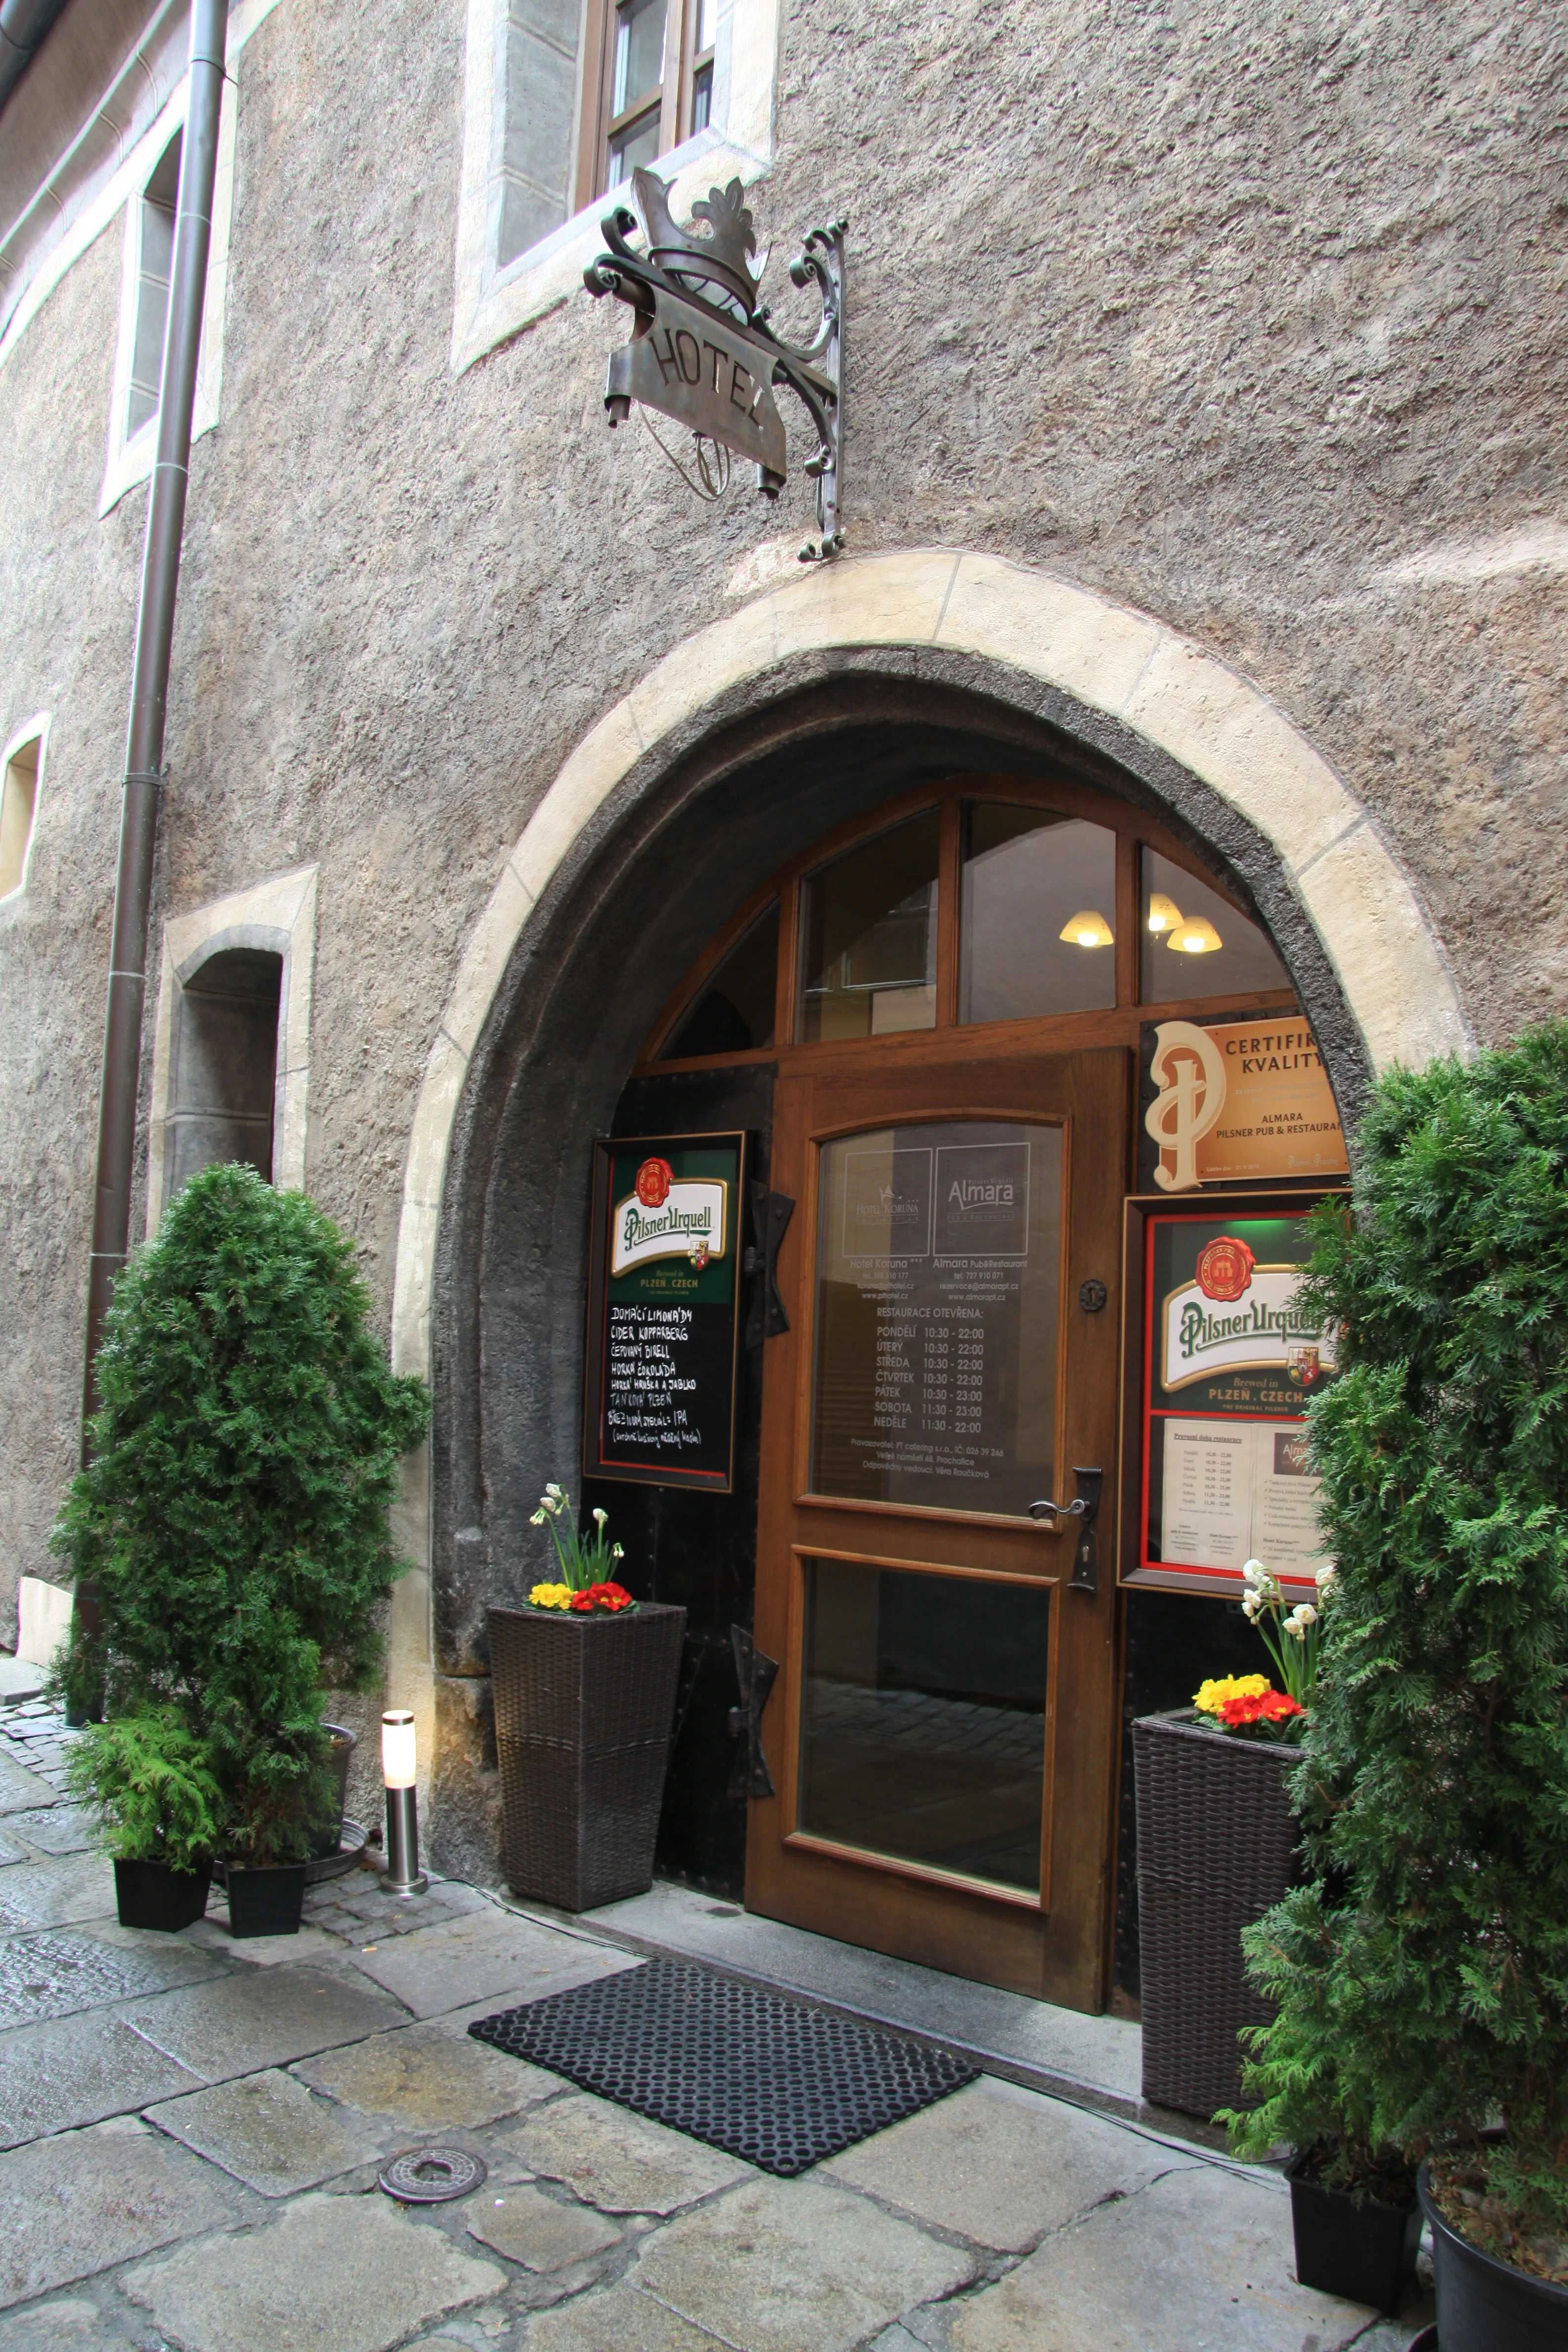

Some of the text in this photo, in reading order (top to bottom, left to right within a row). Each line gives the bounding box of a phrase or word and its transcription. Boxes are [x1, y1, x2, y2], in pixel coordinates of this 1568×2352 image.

[649, 328, 765, 430] HOTEL
[1225, 1032, 1317, 1055] CERTIFIK
[1262, 1113, 1303, 1124] ALMARA
[1217, 1122, 1341, 1139] PILSNER PUB & RESTAURA
[948, 1180, 1013, 1211] Almara
[624, 1205, 711, 1251] Pilsner Urquell
[850, 1259, 908, 1268] Hotel Koruna
[932, 1259, 968, 1268] Almara
[672, 1279, 698, 1288] CZECH
[877, 1306, 984, 1318] RESTAURACE OTEVŘENA:
[611, 1325, 688, 1340] CIDER KOPPARBERG
[877, 1324, 917, 1337] PONDĚLÍ
[925, 1327, 949, 1338] 10:30
[958, 1328, 984, 1339] 22:00
[1179, 1301, 1252, 1358] Pilsner
[645, 1345, 670, 1359] BIRELL
[877, 1339, 903, 1352] ÚTERÝ
[925, 1343, 948, 1353] 10:30
[958, 1344, 983, 1355] 22:00
[877, 1355, 910, 1367] STŘEDA
[924, 1358, 948, 1369] 10:30
[957, 1360, 983, 1370] 22:00
[662, 1380, 667, 1390] A
[669, 1379, 696, 1390] JABLKO
[876, 1370, 914, 1382] ČTVRTEK
[924, 1373, 947, 1384] 10:30
[957, 1375, 982, 1385] 22:00
[1233, 1377, 1278, 1387] Brewed in
[875, 1384, 900, 1397] PÁTEK
[923, 1389, 947, 1400] 10:30
[956, 1390, 982, 1401] 23:00
[1260, 1390, 1303, 1403] CZECH
[875, 1402, 912, 1413] SOBOTA
[923, 1404, 946, 1415] 11:30
[956, 1406, 981, 1417] 23:00
[674, 1410, 687, 1425] IPA
[874, 1415, 907, 1428] NEDĚLE
[922, 1420, 946, 1430] 11:30
[955, 1422, 981, 1433] 22:00
